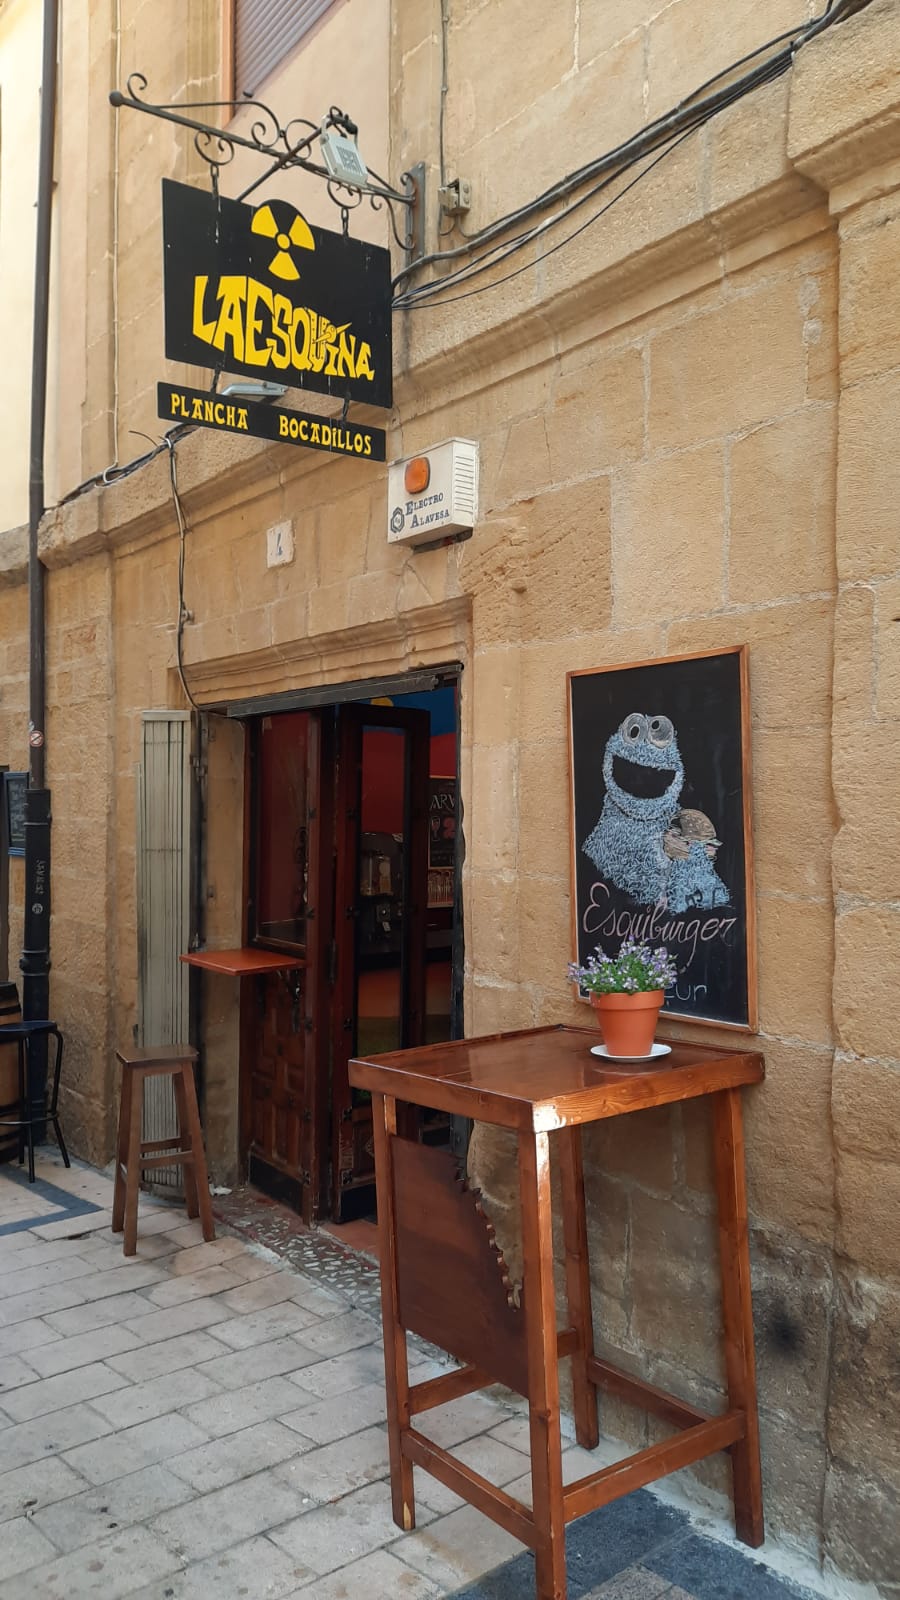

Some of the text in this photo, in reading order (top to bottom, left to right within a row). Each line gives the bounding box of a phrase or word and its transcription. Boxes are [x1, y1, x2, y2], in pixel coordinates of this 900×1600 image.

[170, 393, 249, 430] PLANCHA
[405, 492, 444, 516] ELECTRO
[410, 509, 450, 529] ALAVESA
[583, 881, 737, 968] Esquiburger
[664, 984, 708, 1001] ur
